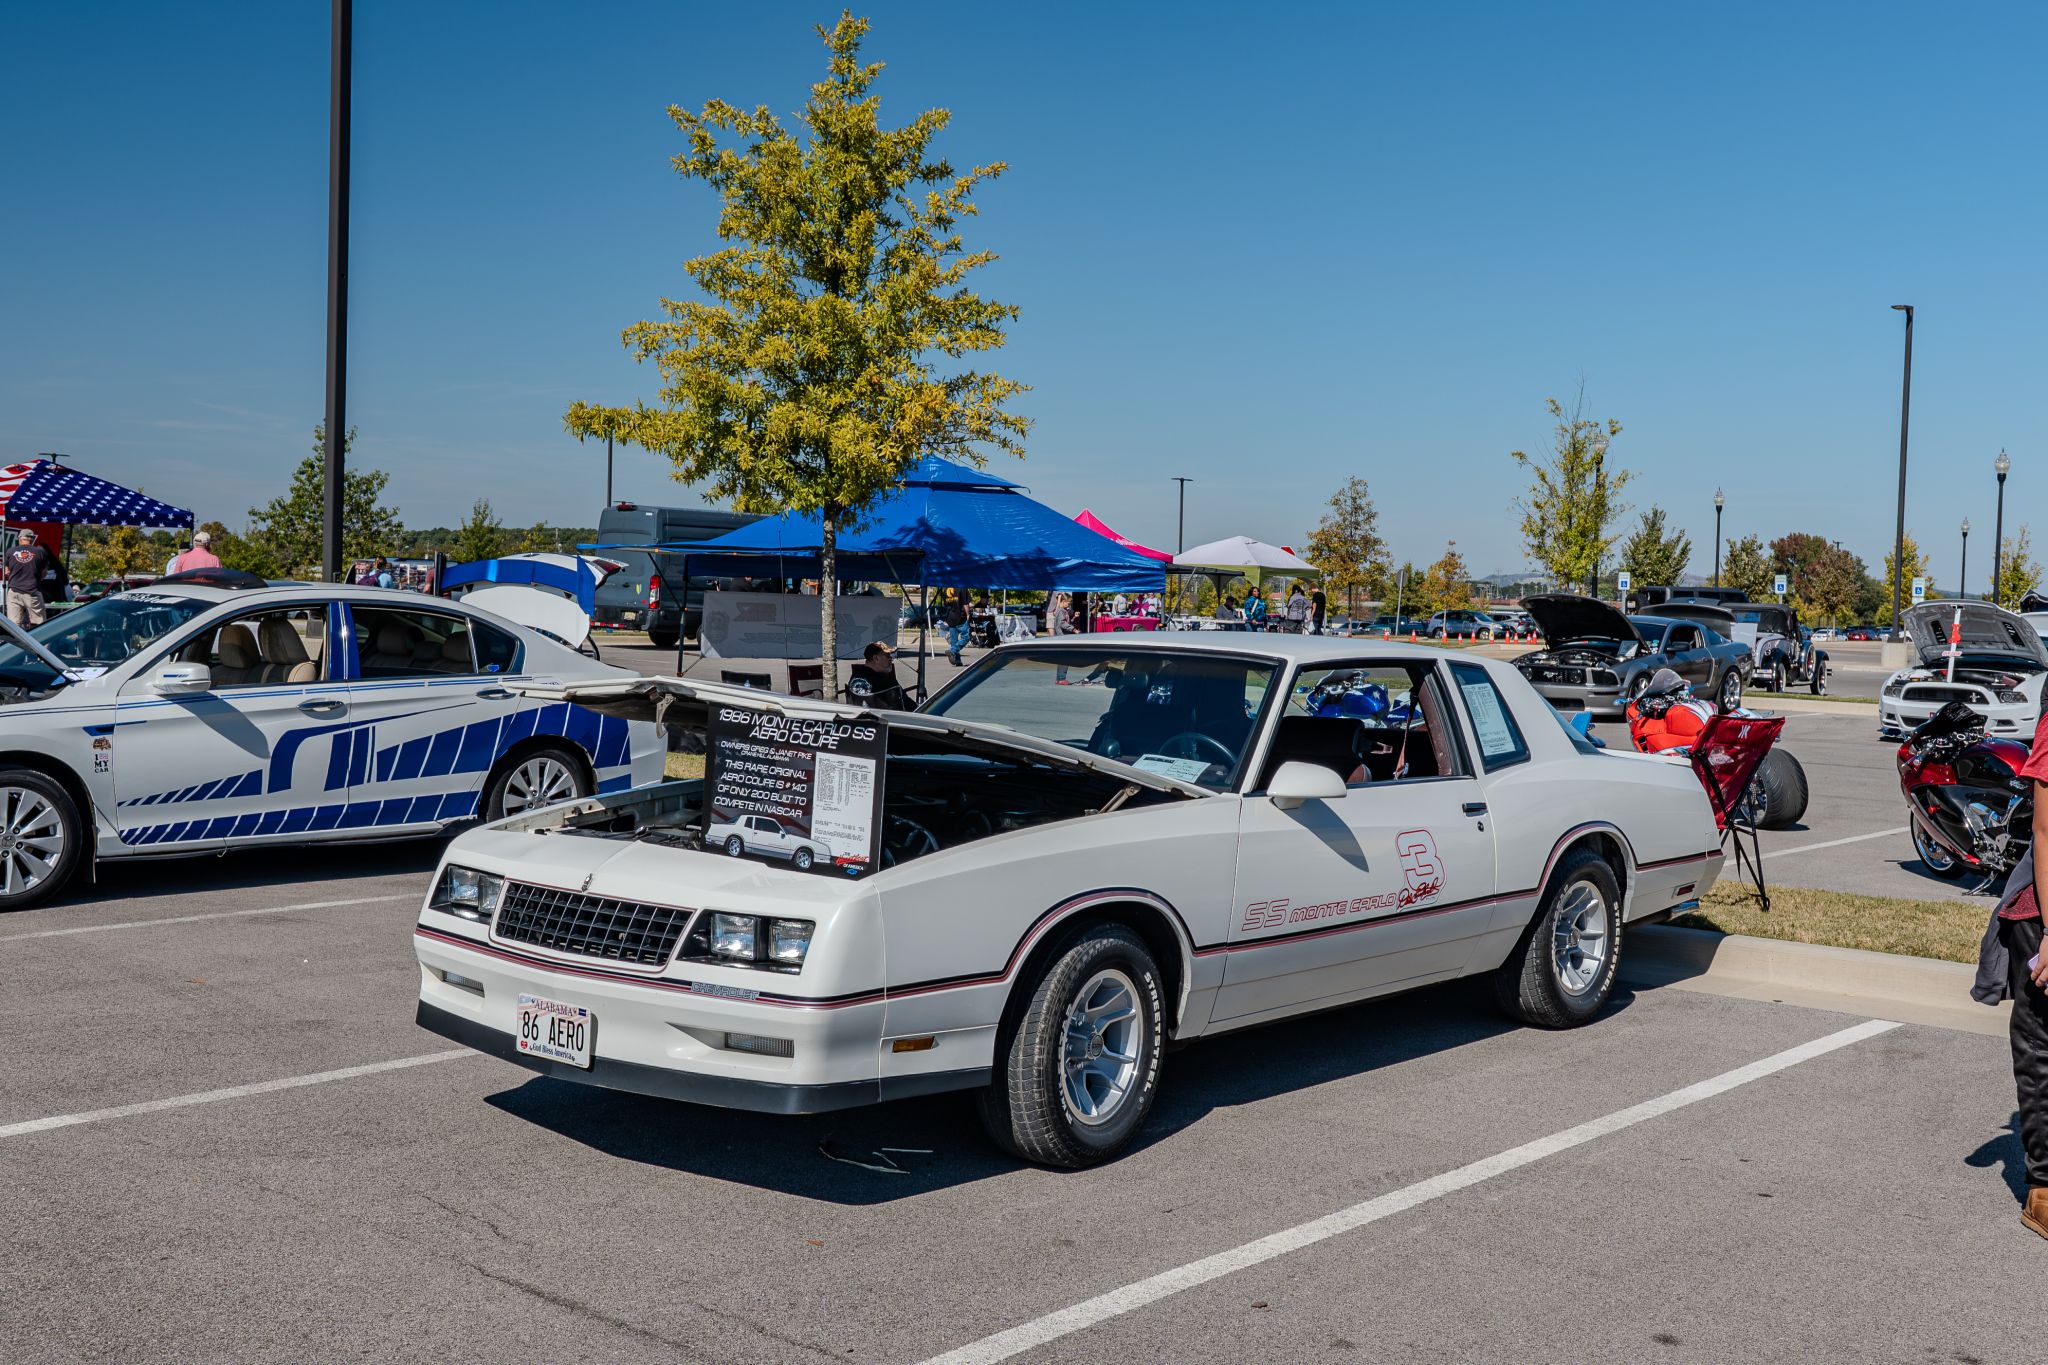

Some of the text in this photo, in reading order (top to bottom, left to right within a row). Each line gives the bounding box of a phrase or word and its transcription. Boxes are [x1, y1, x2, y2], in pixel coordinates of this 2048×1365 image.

[719, 708, 877, 741] 1986 MONTE CARLO SS
[749, 726, 840, 750] AERO COUPE
[750, 745, 770, 754] GREG
[769, 747, 776, 755] &
[775, 748, 798, 759] JANET
[797, 751, 813, 761] PIKE
[94, 760, 109, 769] MY
[725, 759, 808, 780] THIS RARE ORIGINAL
[720, 772, 745, 783] AERO
[744, 775, 776, 789] COUPE
[775, 780, 785, 790] IS
[717, 784, 807, 806] OF ONLY 200 BUILT TO
[713, 796, 803, 819] COMPETE IN NASCAR
[1396, 829, 1446, 894] 3
[1241, 898, 1290, 932] SS
[1289, 901, 1349, 924] MONTE
[1350, 892, 1399, 913] CARLO
[691, 981, 760, 1001] CHEVROLET
[534, 1000, 574, 1017] ALABAMA
[522, 1010, 584, 1052] 86 AERO
